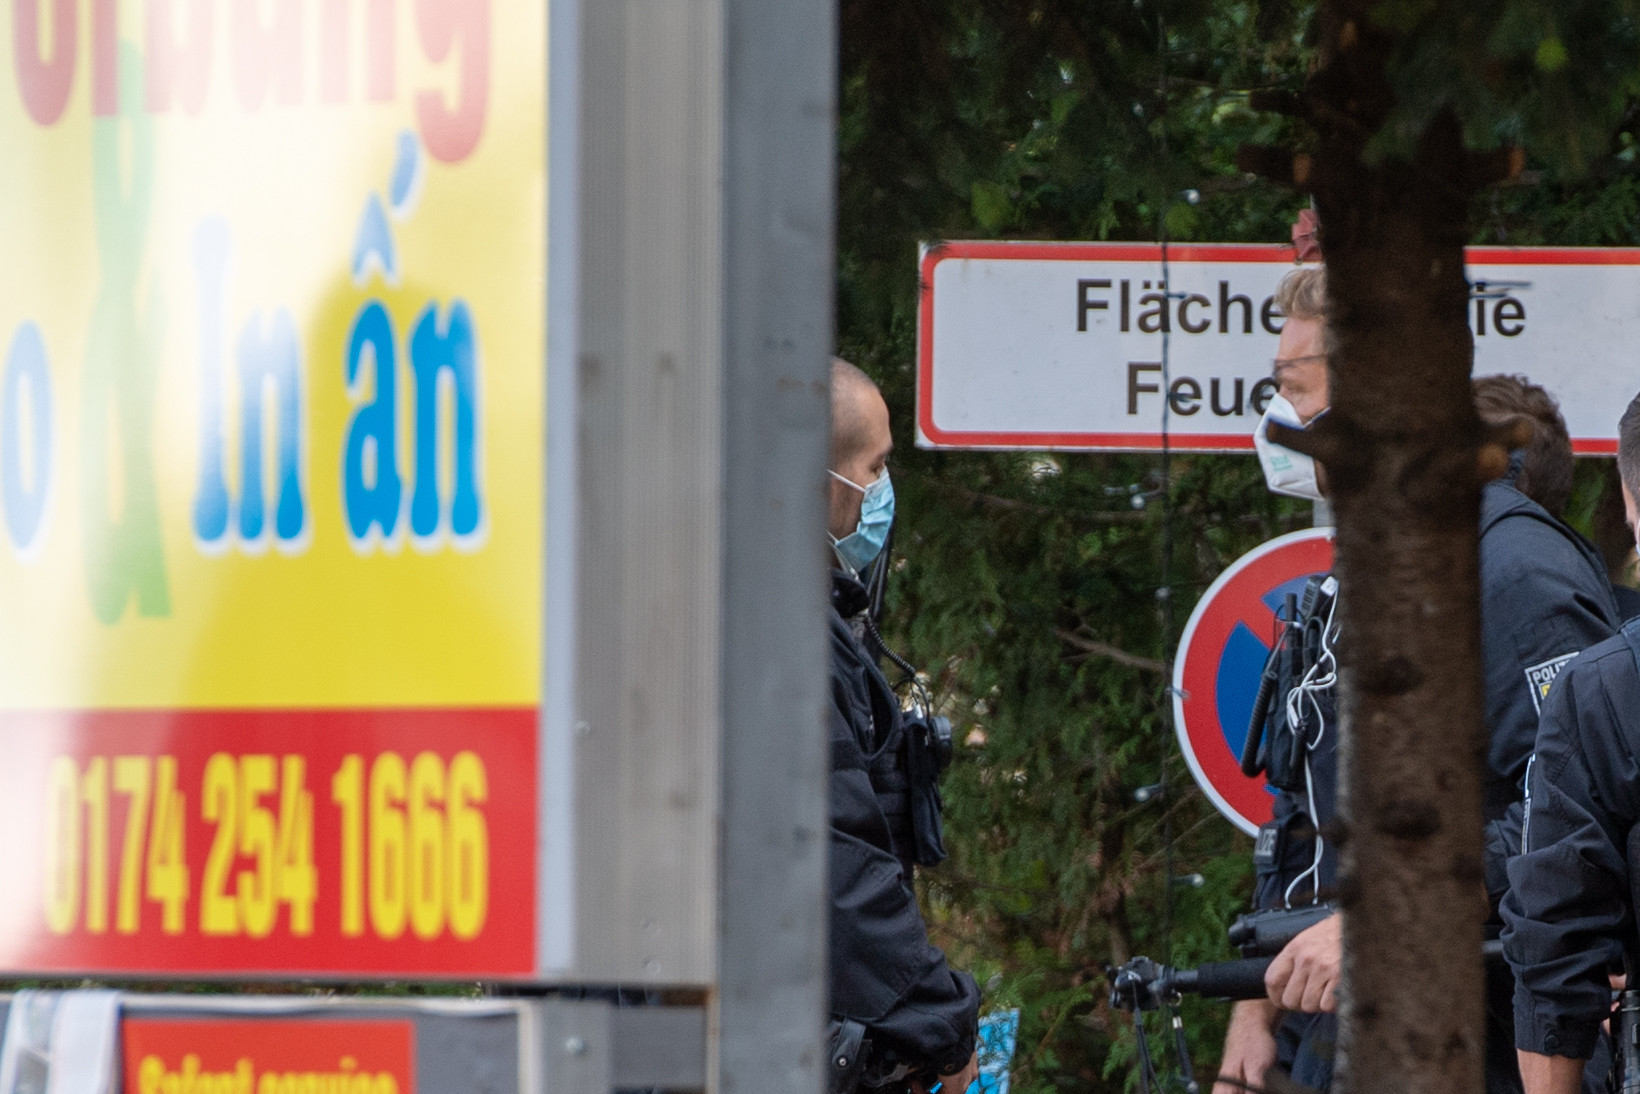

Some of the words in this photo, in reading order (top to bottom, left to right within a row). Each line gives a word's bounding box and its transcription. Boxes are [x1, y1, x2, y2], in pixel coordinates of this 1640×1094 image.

[1077, 278, 1288, 334] Fläche
[1475, 282, 1526, 337] ie
[1126, 361, 1281, 417] Feue
[1532, 660, 1570, 686] POLI
[43, 754, 189, 938] 0174
[199, 752, 318, 940] 254
[332, 751, 490, 941] 1666
